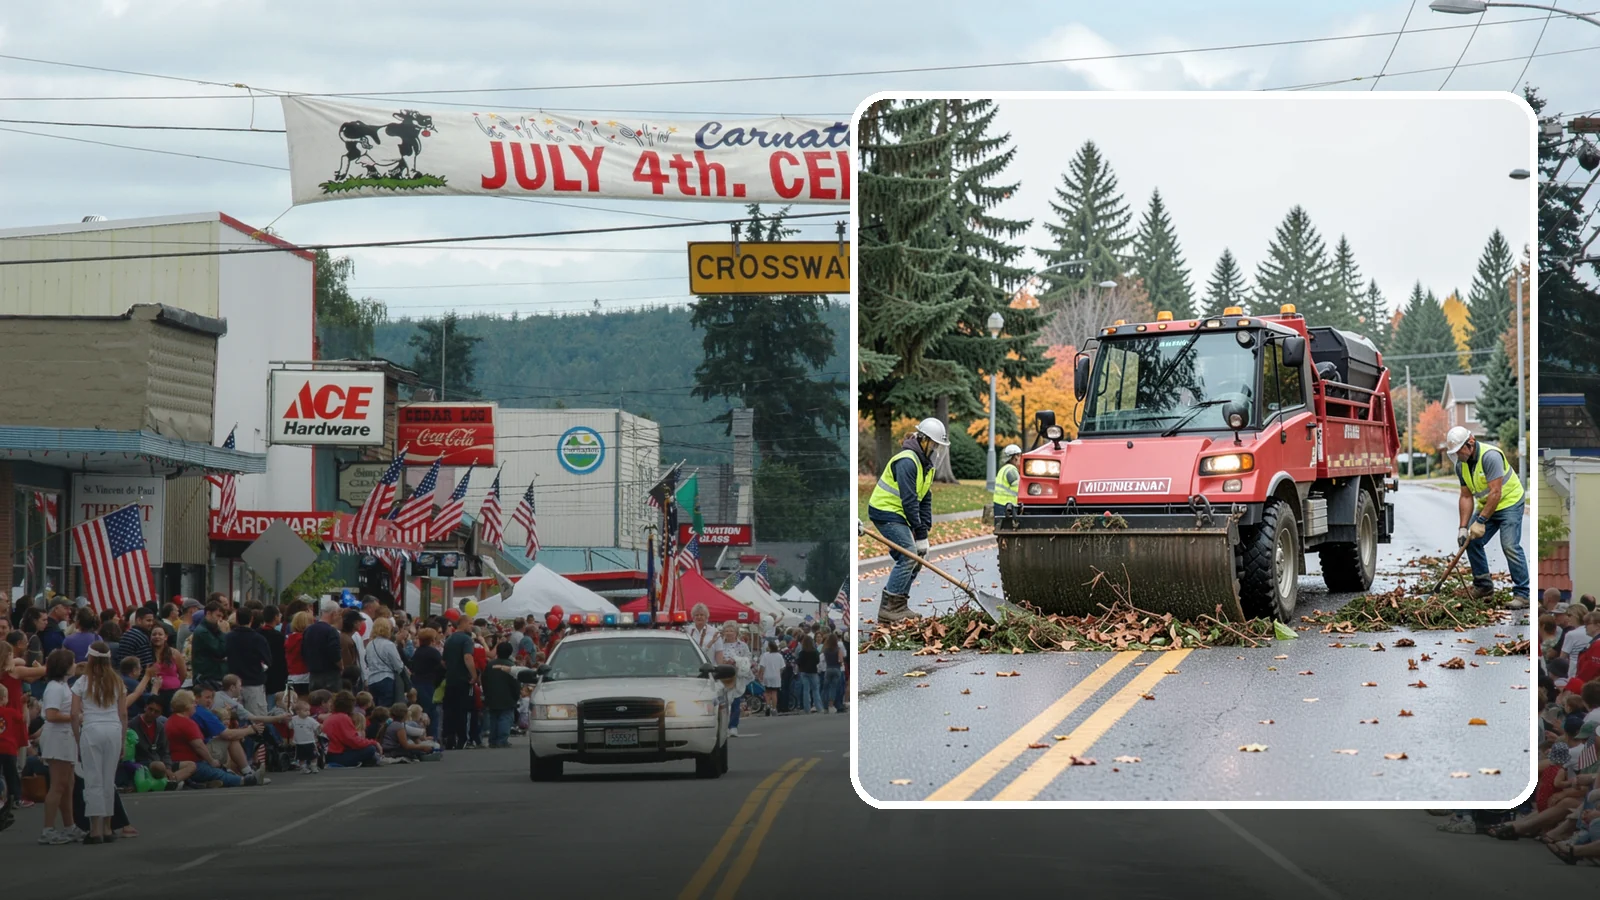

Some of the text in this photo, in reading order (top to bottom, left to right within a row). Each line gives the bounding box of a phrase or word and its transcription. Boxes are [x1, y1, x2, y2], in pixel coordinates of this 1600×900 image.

[481, 141, 605, 192] JULY
[632, 150, 746, 198] 4th.
[697, 254, 850, 280] CROSSWA
[283, 380, 373, 420] ACE
[406, 409, 452, 422] CEDAR
[283, 421, 371, 437] Hardware
[96, 485, 124, 495] Vincent
[126, 485, 136, 495] de
[137, 486, 155, 495] Paul
[688, 526, 742, 535] CRNATION
[699, 535, 731, 543] GLASS
